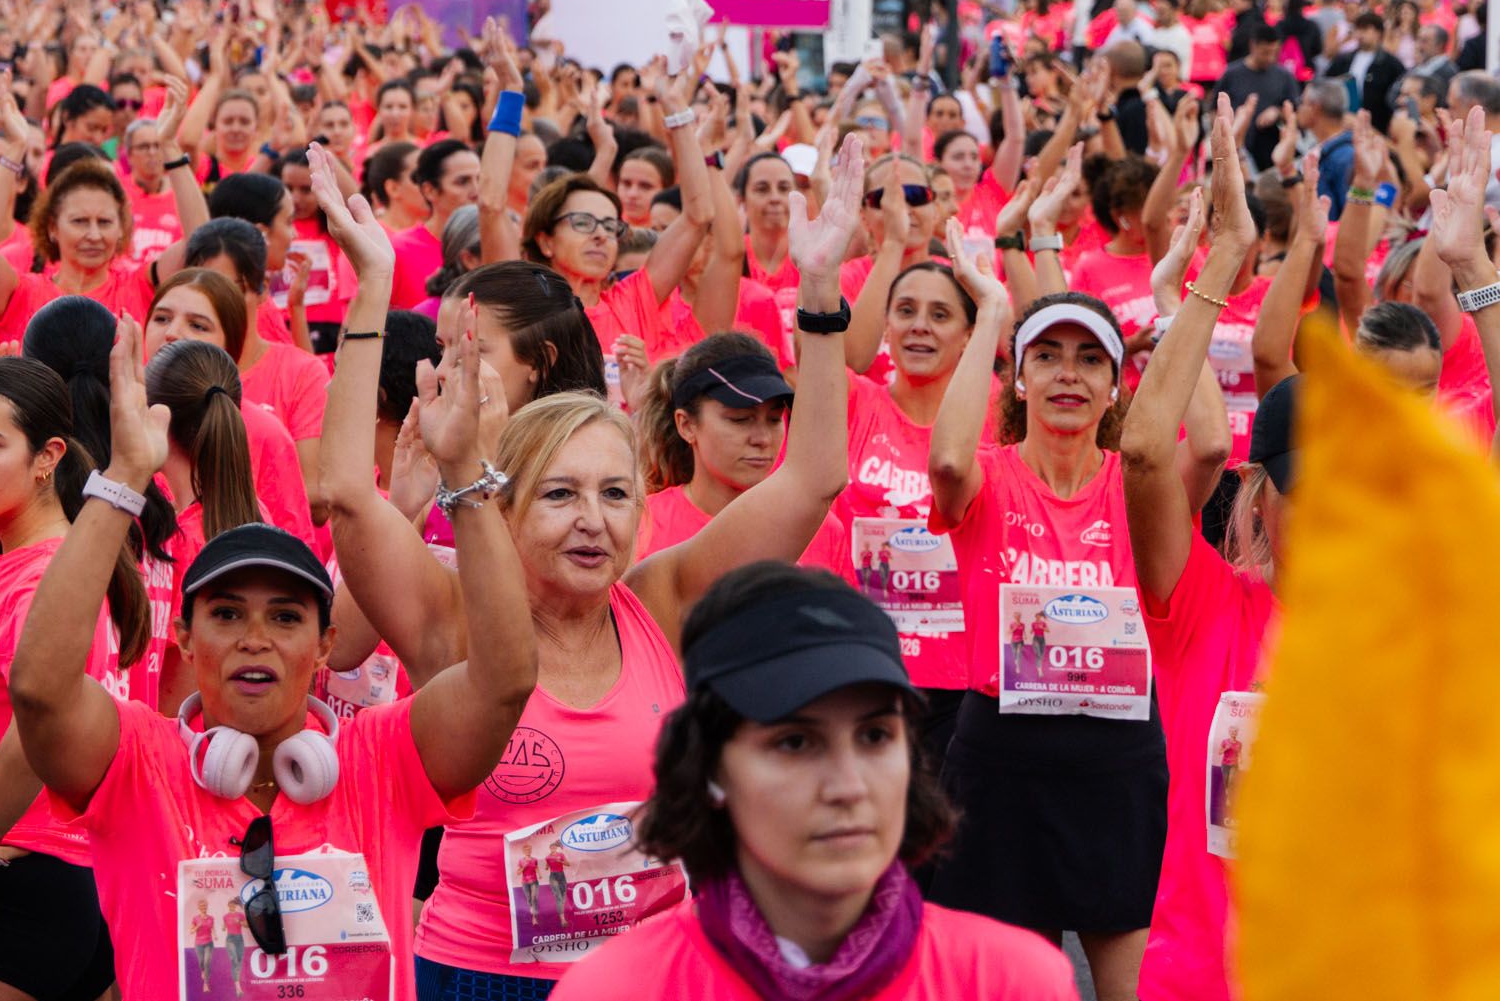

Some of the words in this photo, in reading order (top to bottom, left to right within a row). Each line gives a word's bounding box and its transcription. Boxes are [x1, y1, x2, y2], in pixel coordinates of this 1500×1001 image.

[1217, 370, 1241, 386] 16
[892, 571, 941, 590] 016
[1012, 597, 1041, 606] SUMA
[1050, 604, 1105, 619] ASTURIANA
[1050, 646, 1105, 669] 016
[1066, 671, 1088, 683] 996
[1014, 681, 1048, 692] CARRERA
[1049, 683, 1060, 692] DE
[1060, 683, 1070, 693] LA
[1071, 684, 1095, 694] MUJER
[1100, 684, 1106, 694] A
[1107, 684, 1137, 696] CORUÑA
[326, 694, 355, 719] 016
[1018, 697, 1063, 708] OYSHO
[1091, 701, 1133, 712] Santander
[567, 825, 631, 844] ASTURIANA
[195, 878, 235, 889] SUMA
[249, 885, 327, 902] AURIANA
[572, 875, 637, 910] 016
[592, 910, 625, 927] 1253
[574, 930, 586, 939] DE
[588, 928, 599, 937] LA
[531, 940, 590, 954] OYSHO
[250, 945, 329, 979] 016
[277, 984, 305, 999] 336
